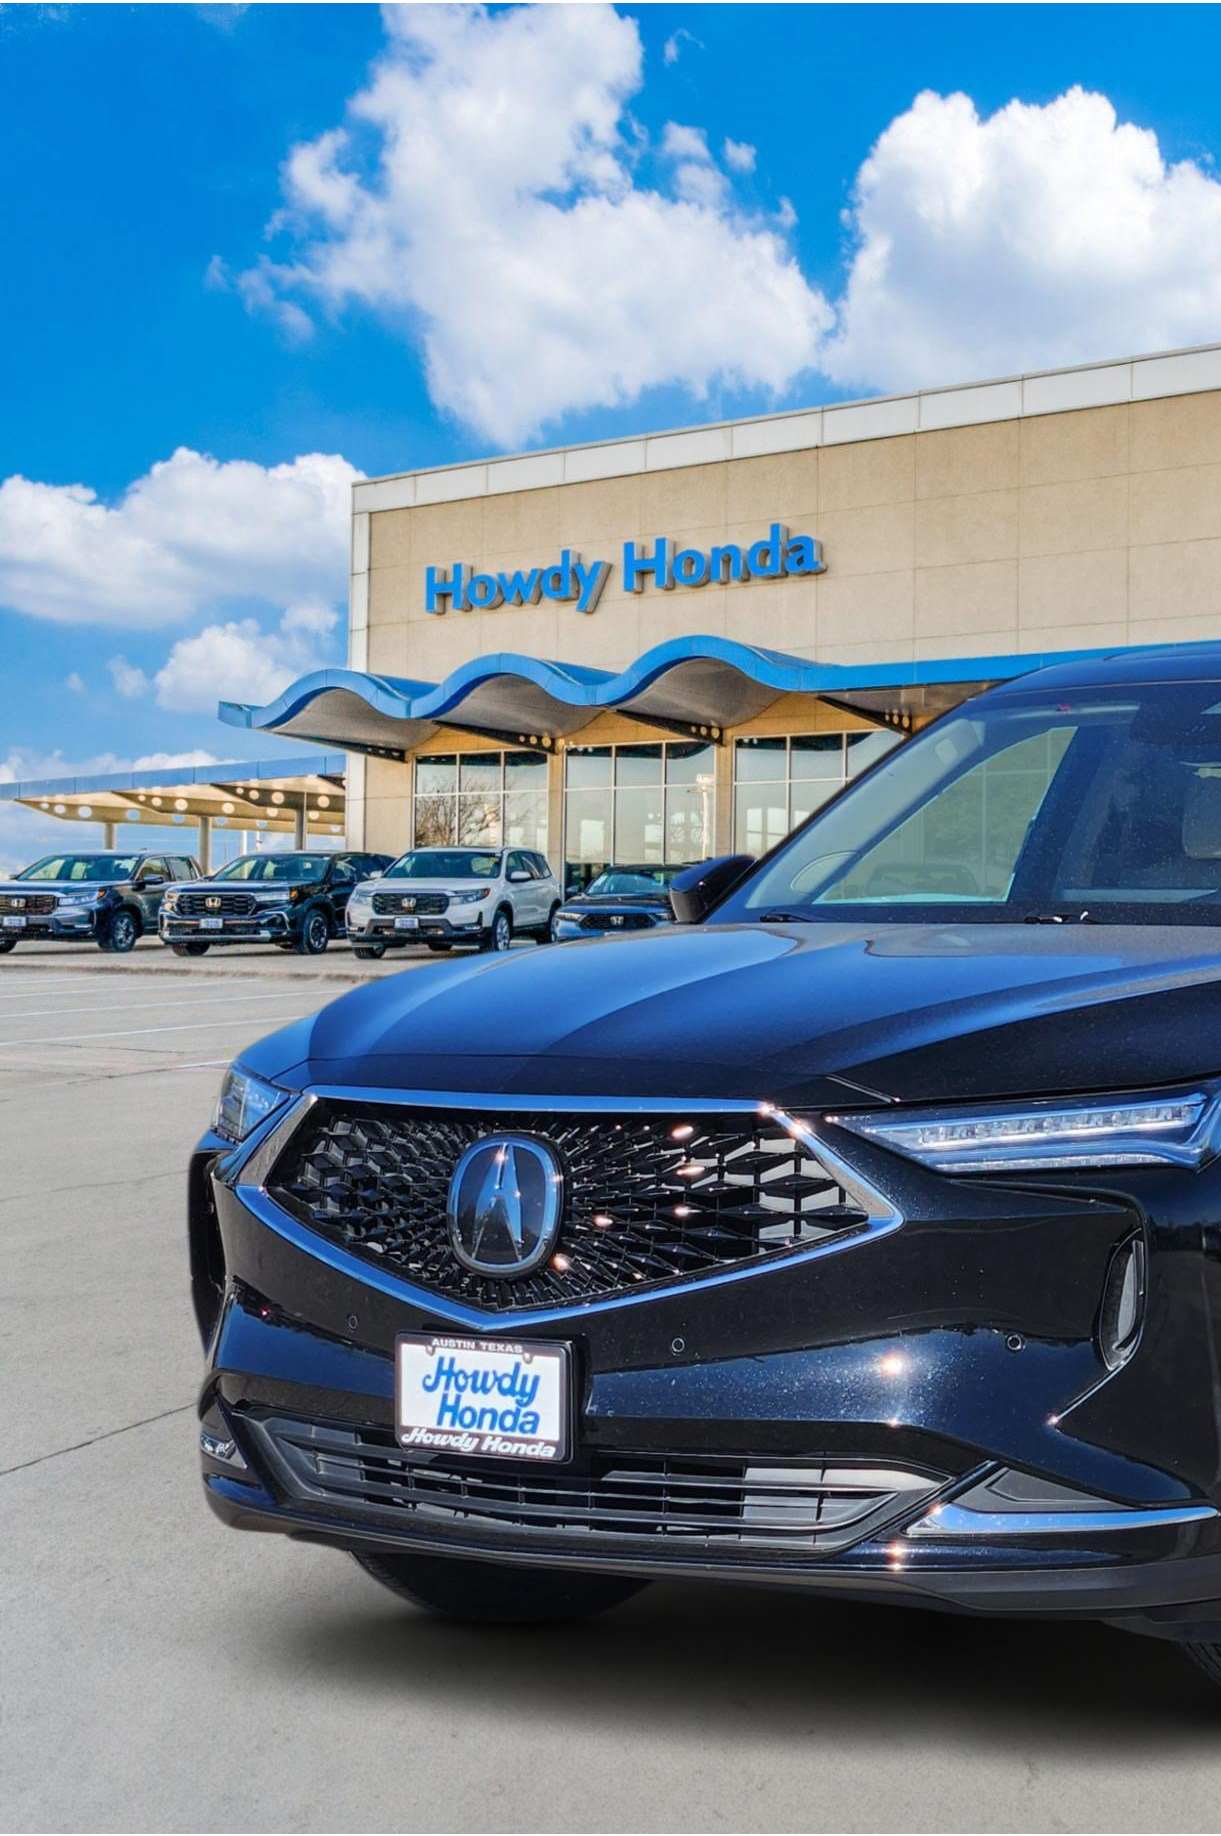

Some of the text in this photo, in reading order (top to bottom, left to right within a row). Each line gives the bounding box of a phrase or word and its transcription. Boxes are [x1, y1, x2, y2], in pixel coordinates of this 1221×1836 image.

[424, 522, 827, 615] Howdy Honda
[431, 1337, 523, 1353] AUSTIN TEXAS
[421, 1356, 541, 1408] Howdy
[436, 1393, 541, 1435] Honda
[401, 1427, 557, 1458] Howdy Honda
